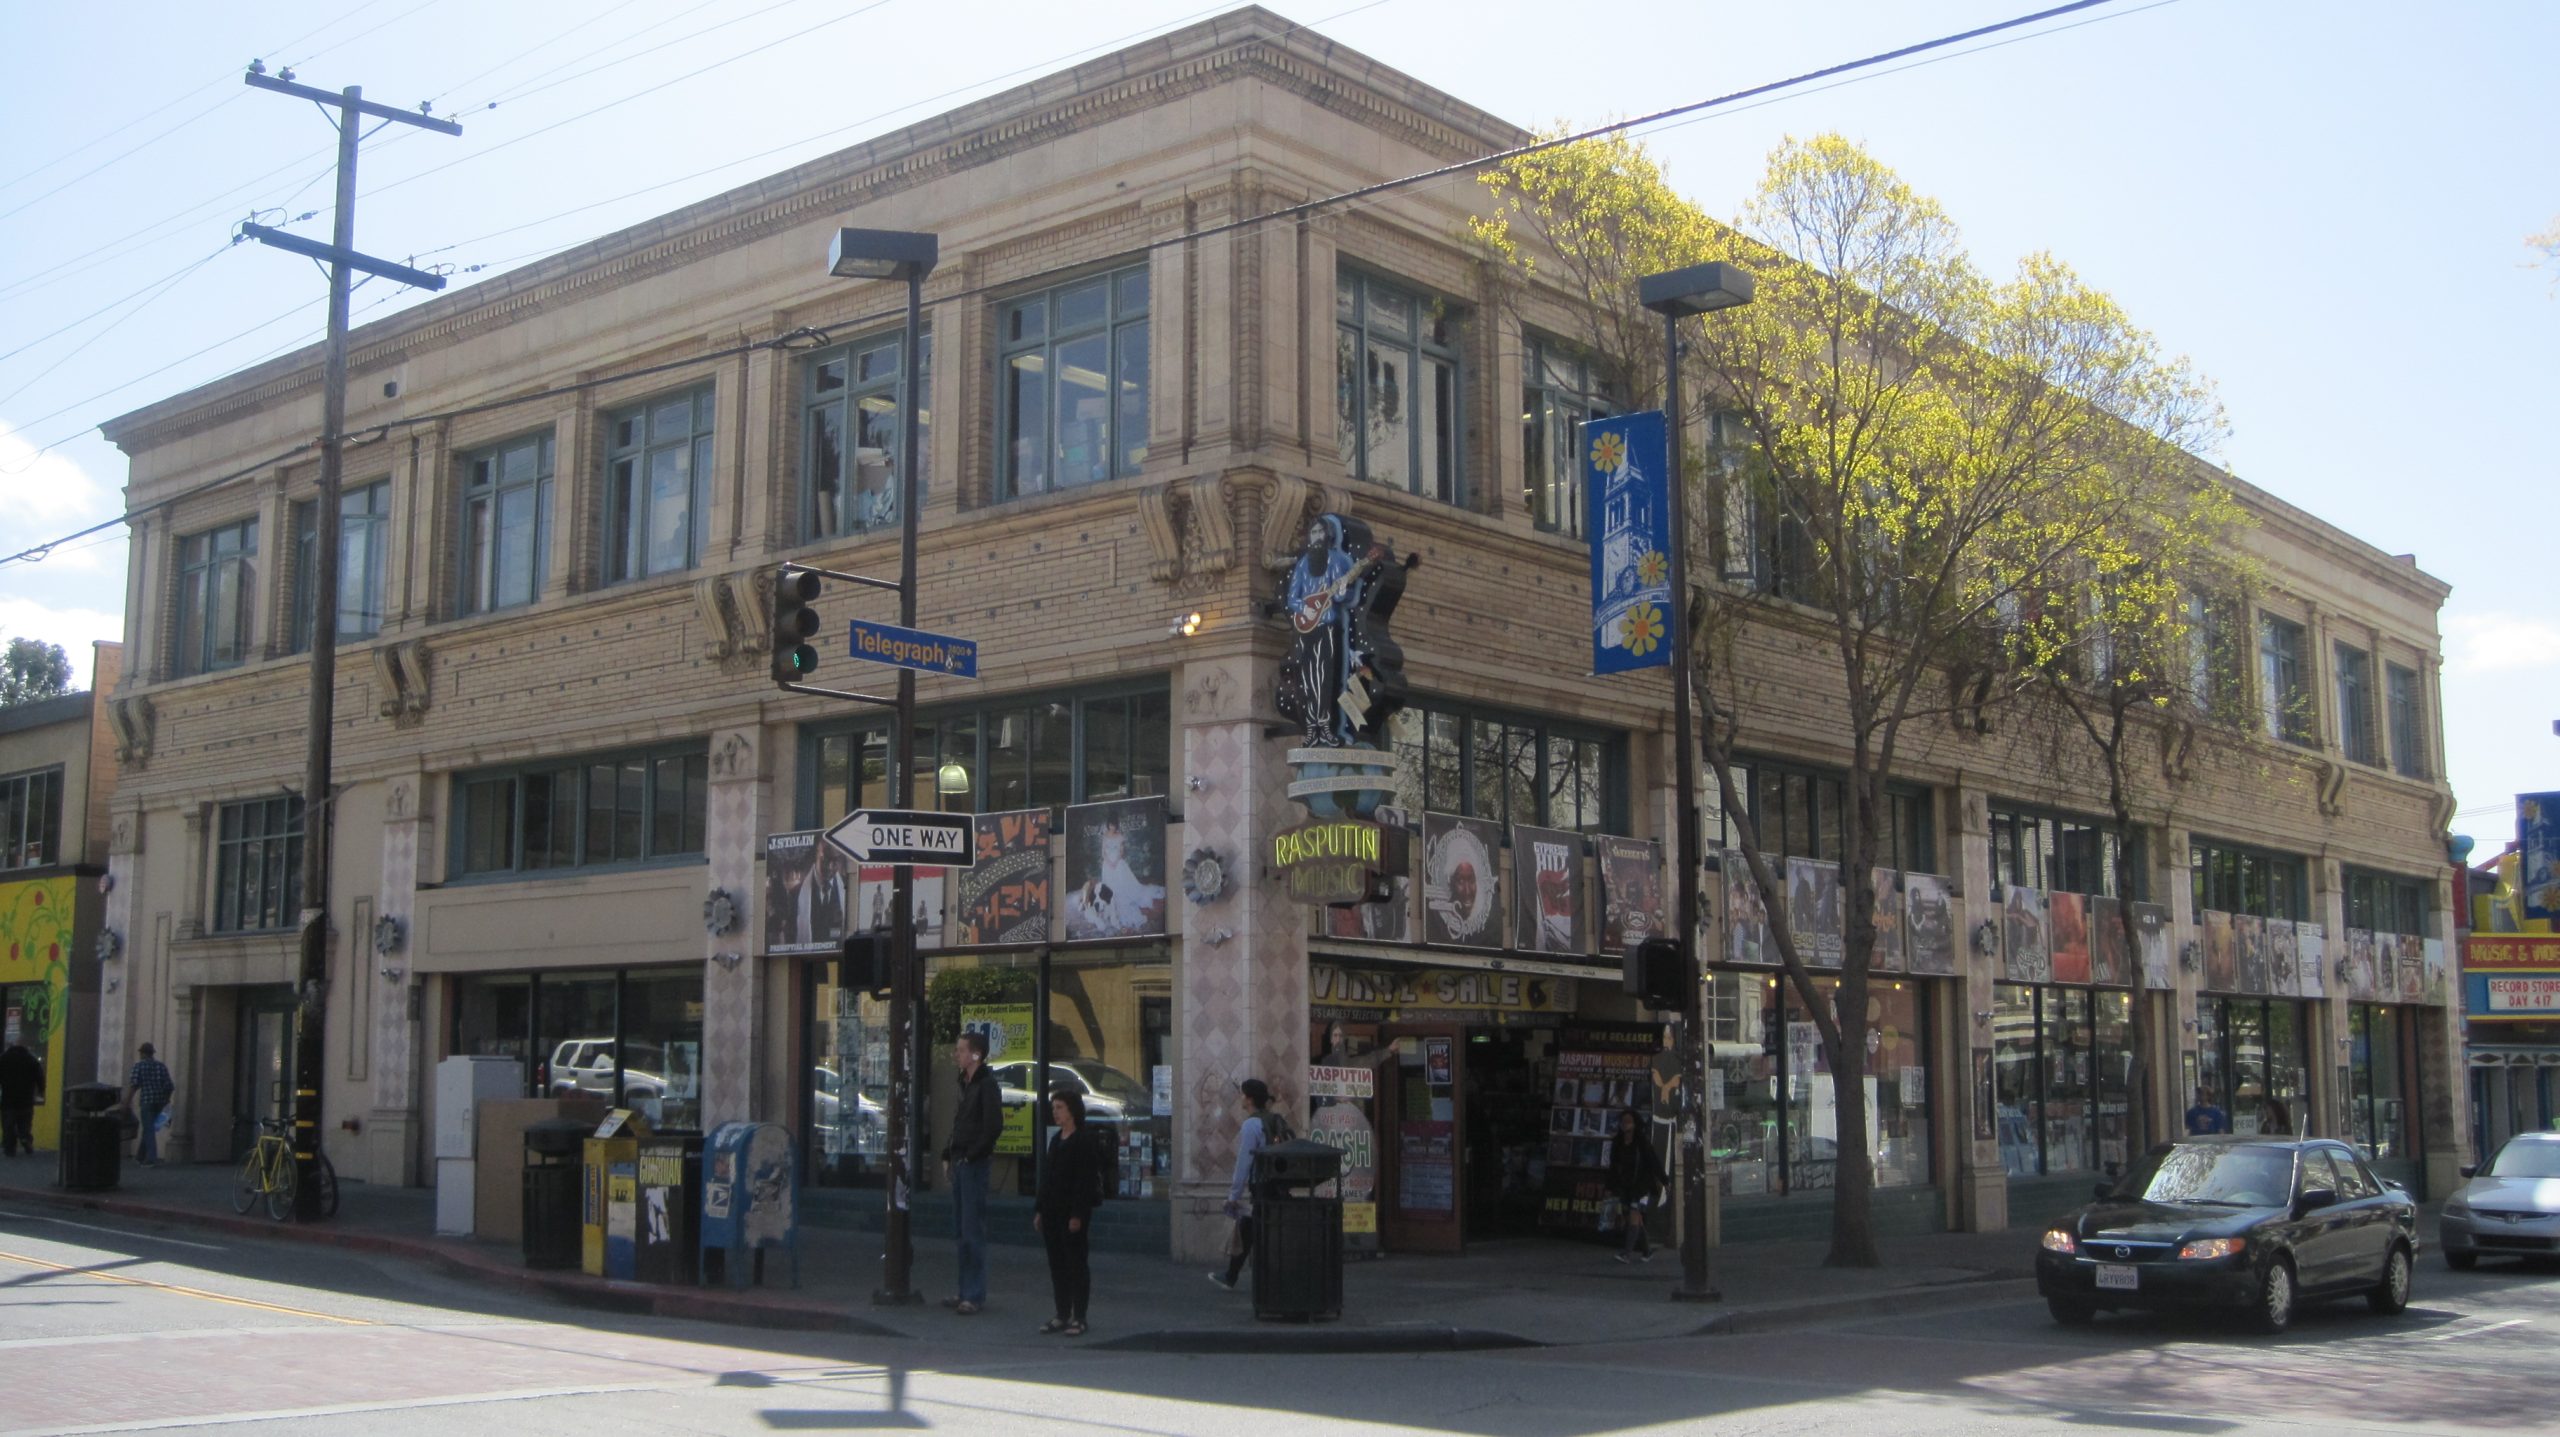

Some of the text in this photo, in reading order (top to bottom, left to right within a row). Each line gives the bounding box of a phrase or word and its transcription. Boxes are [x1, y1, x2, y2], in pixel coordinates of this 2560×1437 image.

[855, 627, 945, 666] Telegraph
[768, 834, 815, 849] J.STALIN
[871, 827, 959, 849] ONE WAY
[1276, 823, 1379, 868] RASPUTIN
[1533, 842, 1569, 857] CYPRESS
[1535, 855, 1569, 871] HILL
[1291, 863, 1366, 897] MUSIC
[2470, 944, 2513, 961] MUSIC
[2518, 944, 2528, 961] &
[1311, 966, 1418, 1002] VINYL
[1436, 973, 1520, 1006] SALE
[2491, 981, 2560, 993] RECORD STORE
[2509, 994, 2528, 1007] DAY
[1559, 1052, 1602, 1066] RASPUTIN
[1309, 1066, 1372, 1084] RASPUTIN
[640, 1156, 683, 1186] GUARDIAN
